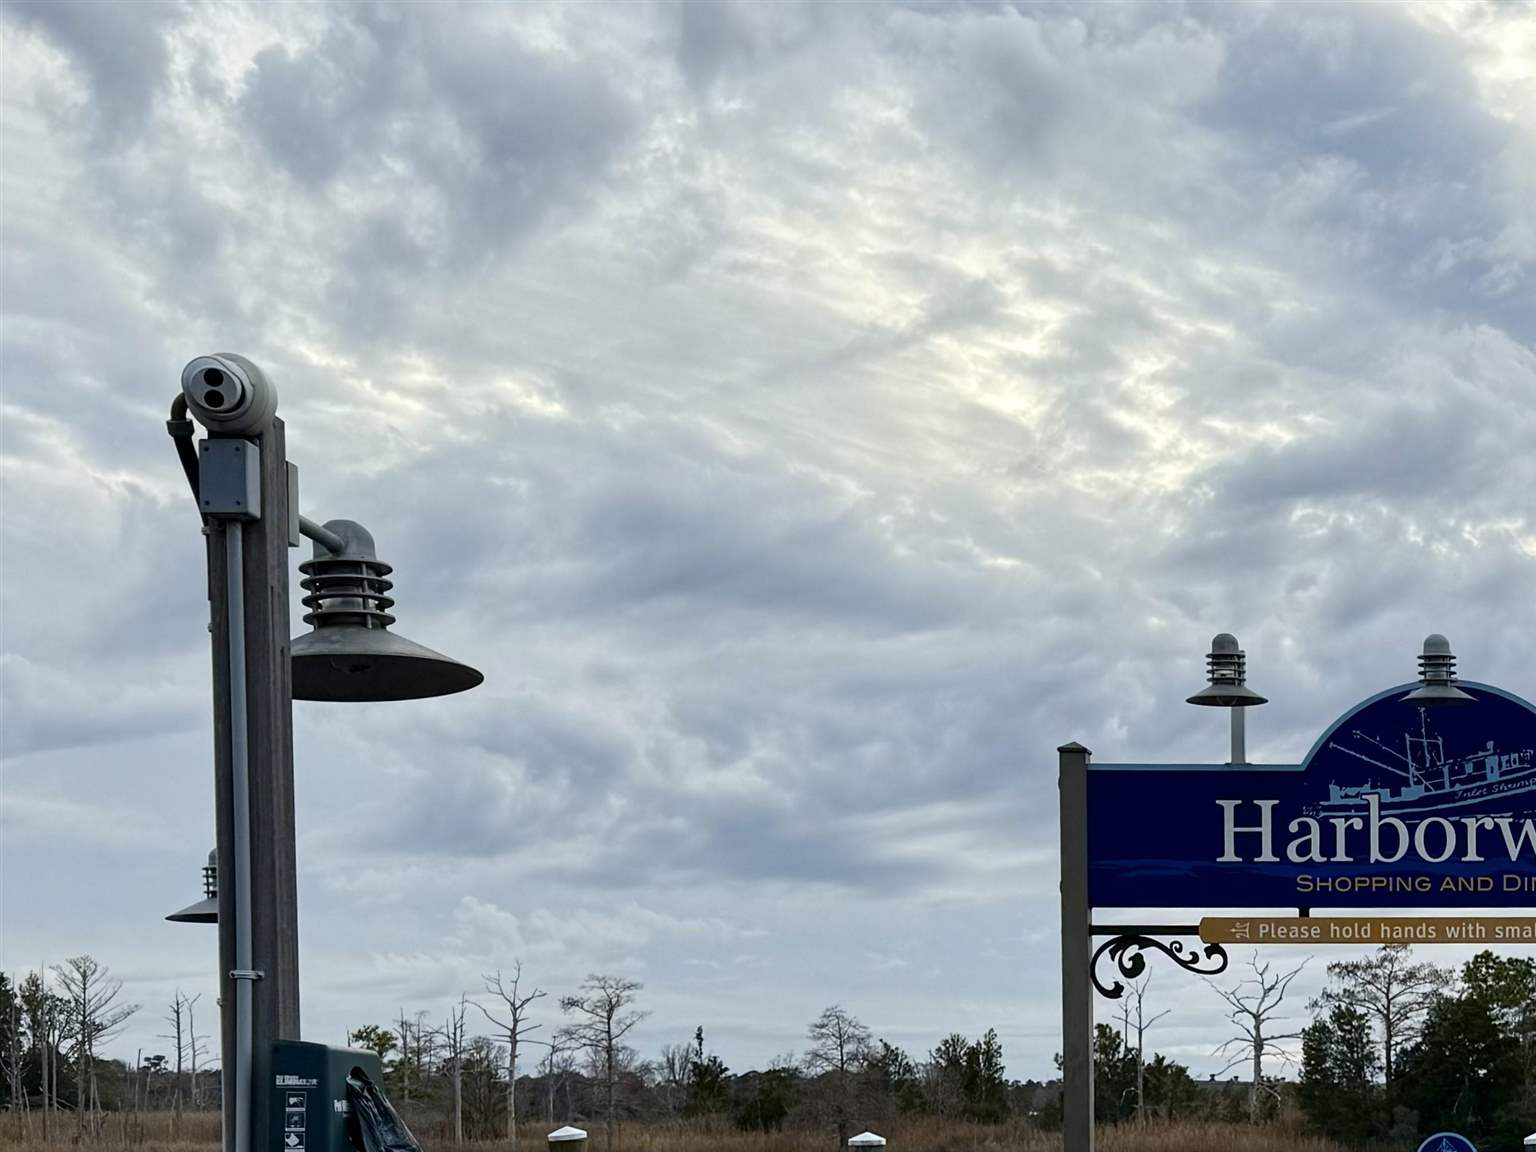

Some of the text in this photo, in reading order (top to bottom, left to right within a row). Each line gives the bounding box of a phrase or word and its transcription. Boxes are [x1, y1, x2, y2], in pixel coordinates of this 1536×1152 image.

[1296, 874, 1432, 893] SHOPPING
[1258, 923, 1321, 939] Please
[1330, 922, 1371, 939] hold
[1380, 922, 1436, 939] hands
[1446, 922, 1486, 938] with
